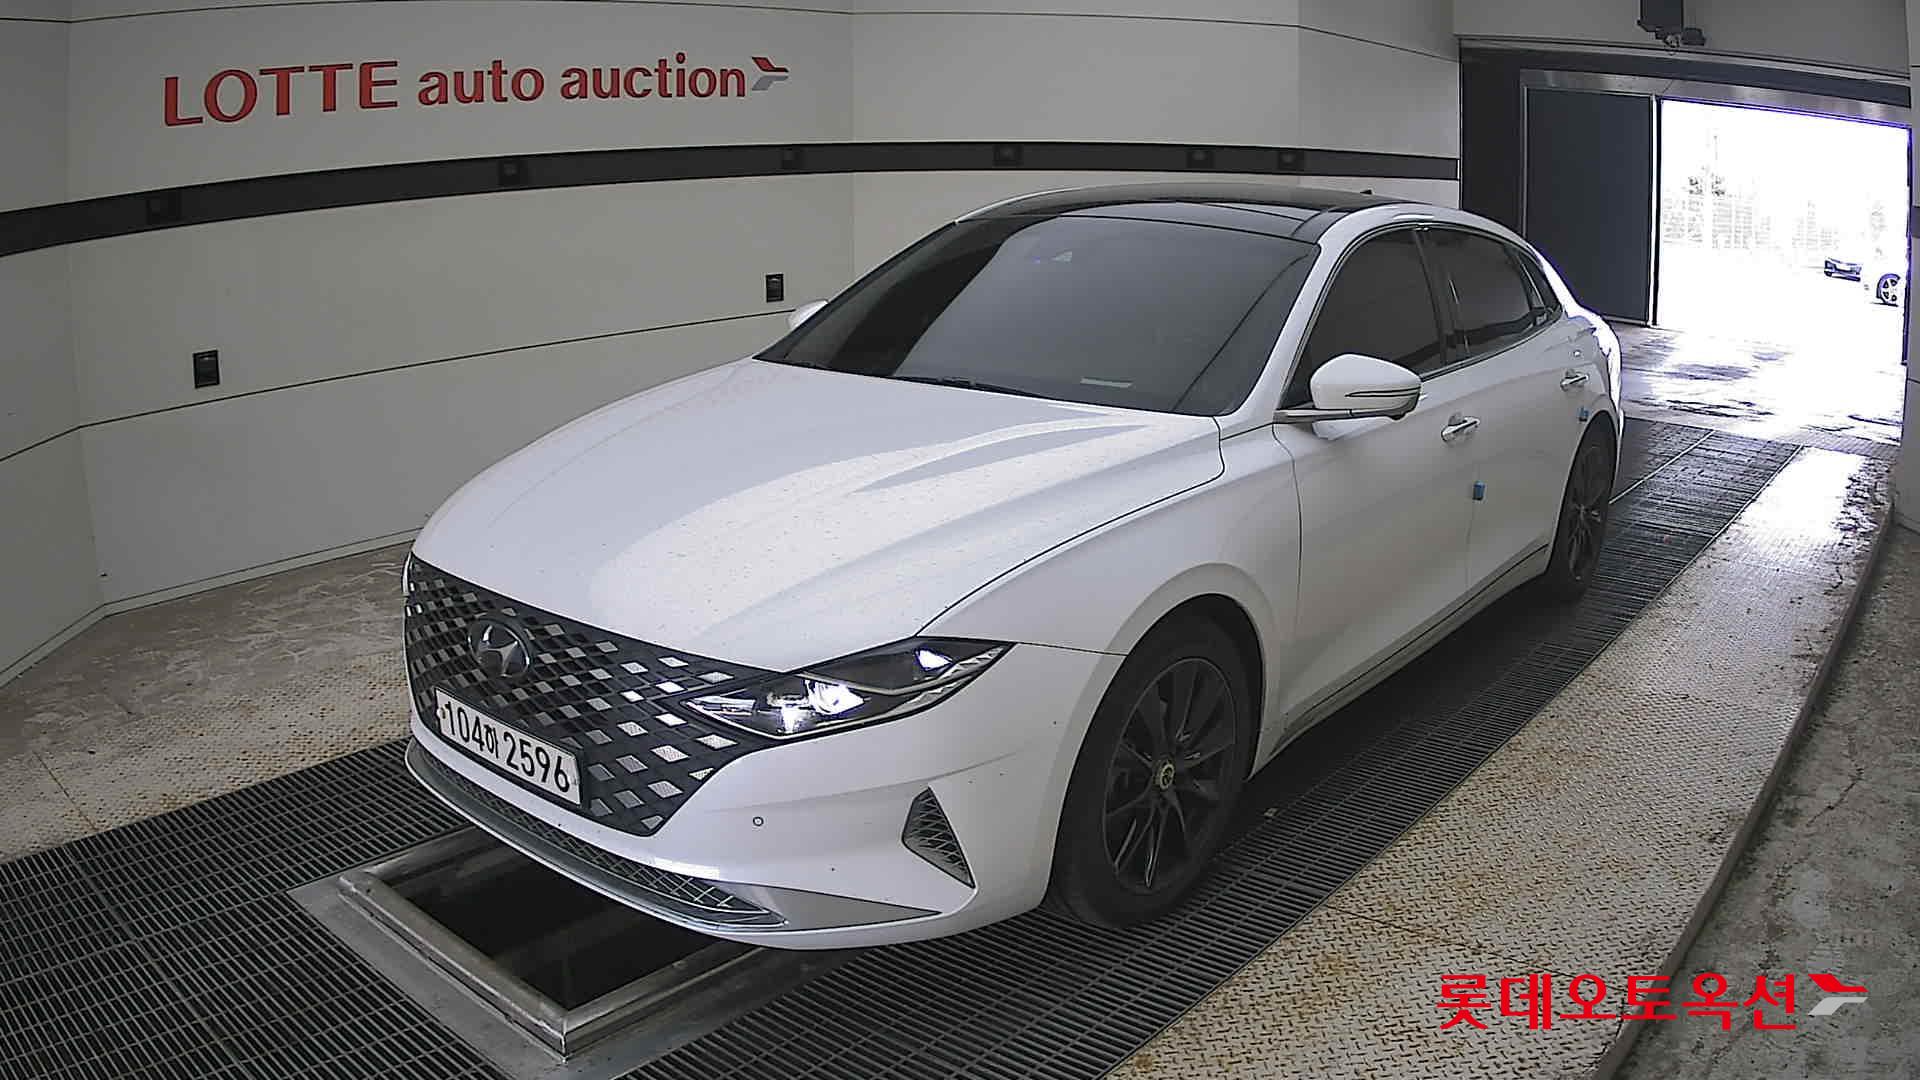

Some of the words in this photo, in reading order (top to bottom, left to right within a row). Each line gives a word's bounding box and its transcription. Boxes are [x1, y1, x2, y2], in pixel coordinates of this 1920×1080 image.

[164, 60, 398, 127] LOTTE
[418, 60, 545, 106] auto
[560, 52, 747, 99] auction
